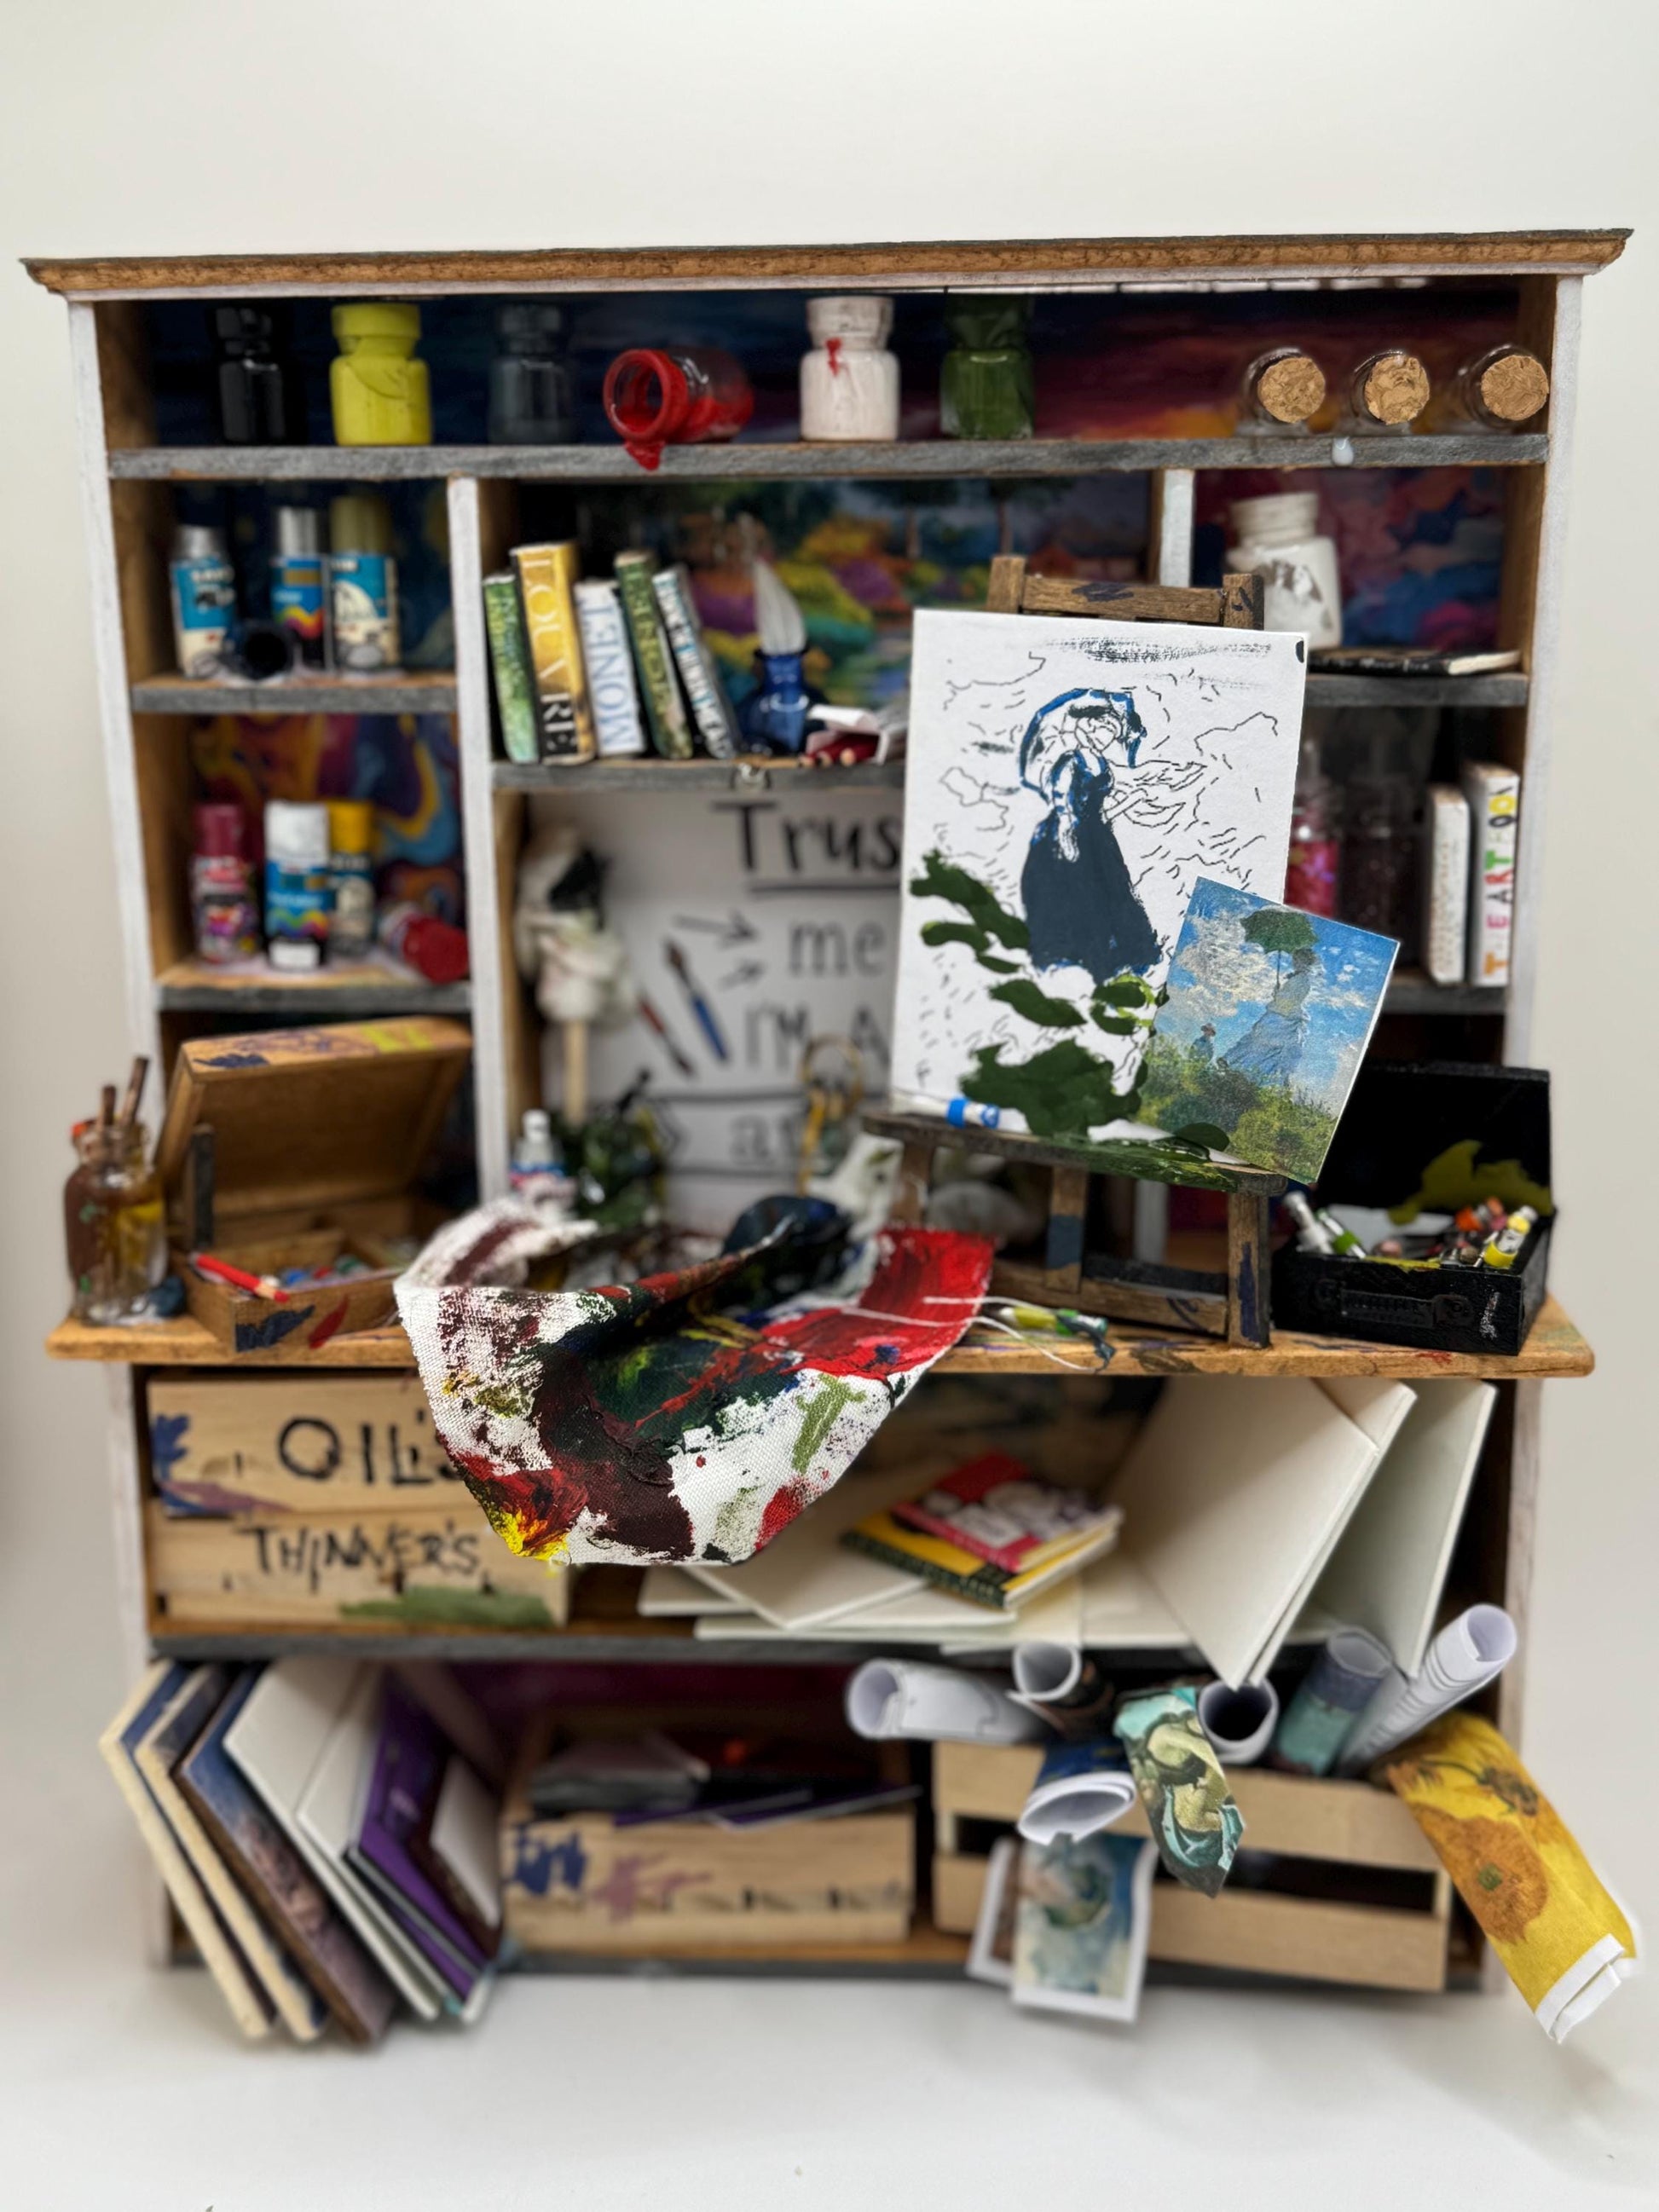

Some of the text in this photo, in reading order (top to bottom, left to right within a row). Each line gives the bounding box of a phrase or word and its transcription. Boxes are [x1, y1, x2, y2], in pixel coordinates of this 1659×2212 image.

[521, 559, 578, 752] LOUVRE
[578, 598, 636, 747] MONET
[711, 800, 901, 872] Trus
[1483, 849, 1514, 904] ART
[788, 918, 886, 978] me
[1483, 914, 1509, 976] TE
